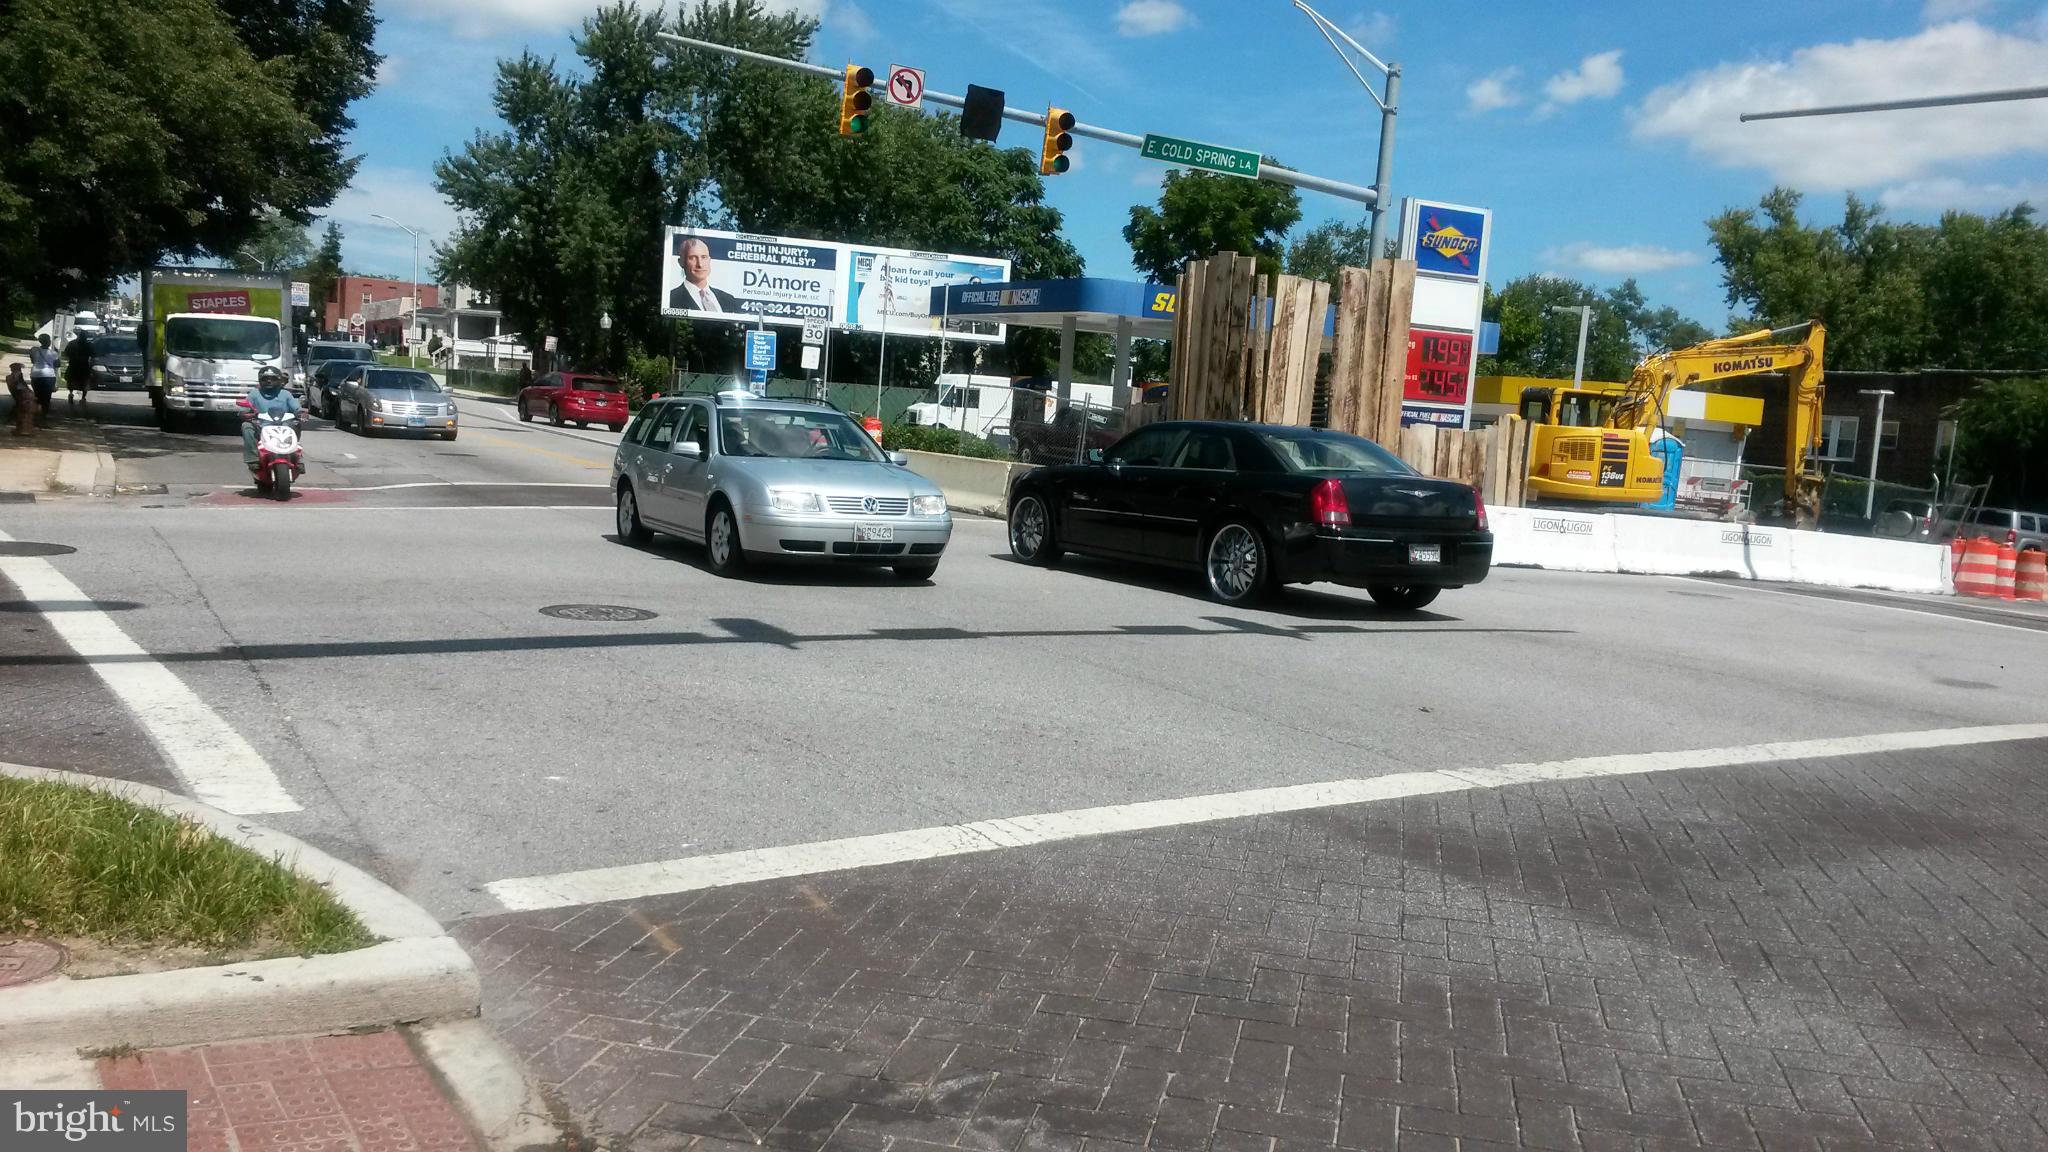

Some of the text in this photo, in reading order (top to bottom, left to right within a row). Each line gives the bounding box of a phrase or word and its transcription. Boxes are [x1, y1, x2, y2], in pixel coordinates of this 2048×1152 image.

[1147, 140, 1157, 155] E.
[1162, 142, 1193, 160] COLD
[1195, 149, 1237, 168] SPRING
[736, 242, 809, 257] BIRTH INJURY?
[1424, 232, 1478, 254] SUNOCO
[727, 250, 817, 267] CEREBRAL PALSY?
[743, 269, 821, 293] D'Amore
[889, 266, 907, 275] loan
[909, 266, 922, 276] for
[923, 268, 933, 277] all
[934, 271, 955, 281] your
[894, 275, 909, 284] kid
[742, 288, 772, 298] Personal
[773, 289, 793, 300] Injury
[962, 290, 1001, 303] OFFICIAL FUEL
[192, 296, 247, 310] STAPLES
[807, 317, 825, 325] SPEED
[805, 329, 823, 340] 30
[1713, 356, 1774, 373] KOMATSU
